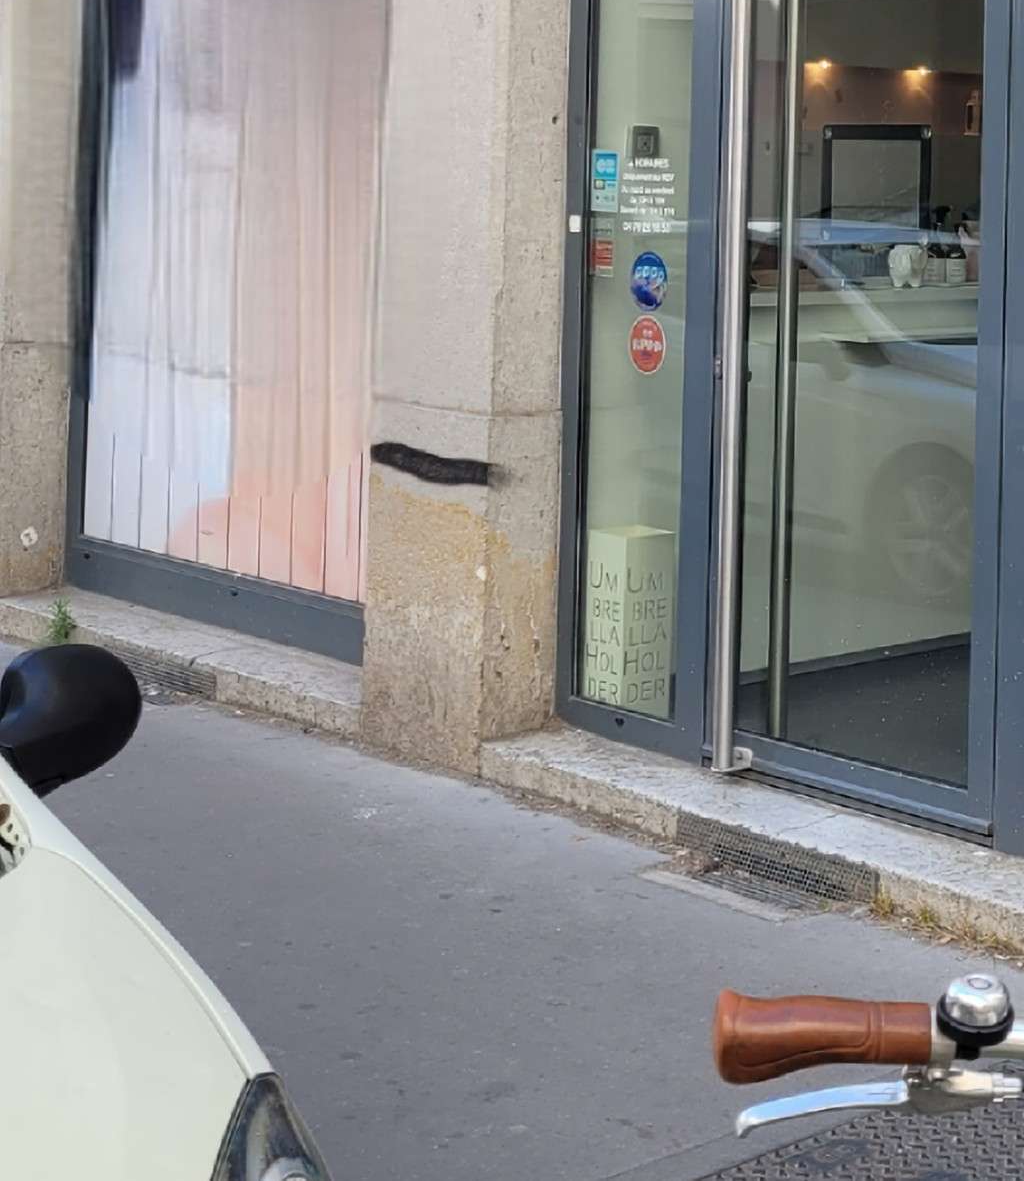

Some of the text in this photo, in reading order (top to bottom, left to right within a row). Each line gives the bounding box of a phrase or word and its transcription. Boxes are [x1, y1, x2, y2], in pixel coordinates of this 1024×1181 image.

[592, 597, 620, 622] BRE
[632, 598, 668, 621] BRE
[590, 621, 620, 647] LLA
[629, 621, 667, 647] LLA
[586, 643, 618, 676] HOL
[624, 649, 665, 676] HOL
[588, 675, 618, 704] DER
[626, 678, 665, 704] DER
